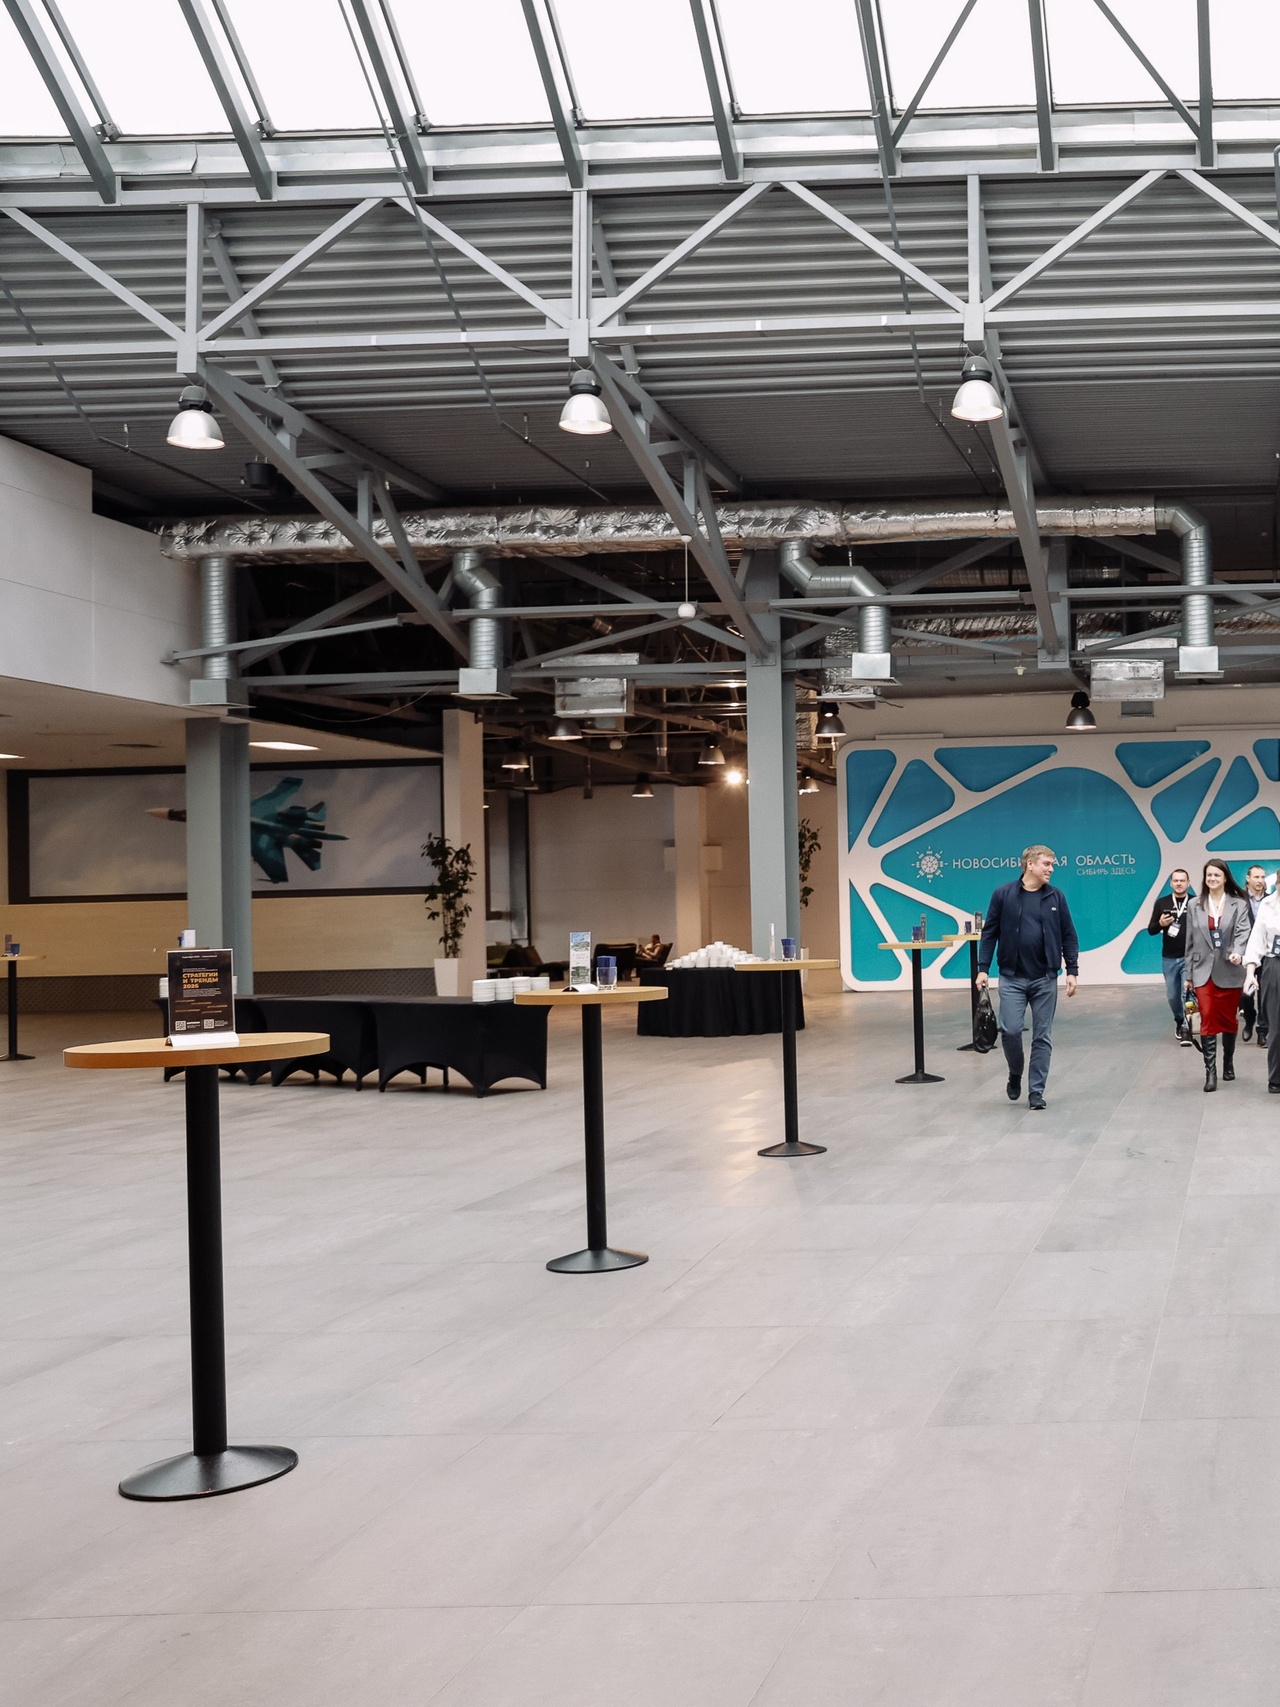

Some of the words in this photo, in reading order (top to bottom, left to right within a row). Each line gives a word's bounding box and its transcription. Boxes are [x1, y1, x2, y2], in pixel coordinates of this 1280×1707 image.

[1075, 853, 1136, 867] ОБЛАСТЬ
[1076, 867, 1108, 876] СИБИРЬ
[1110, 867, 1136, 876] ЗДЕСЬ
